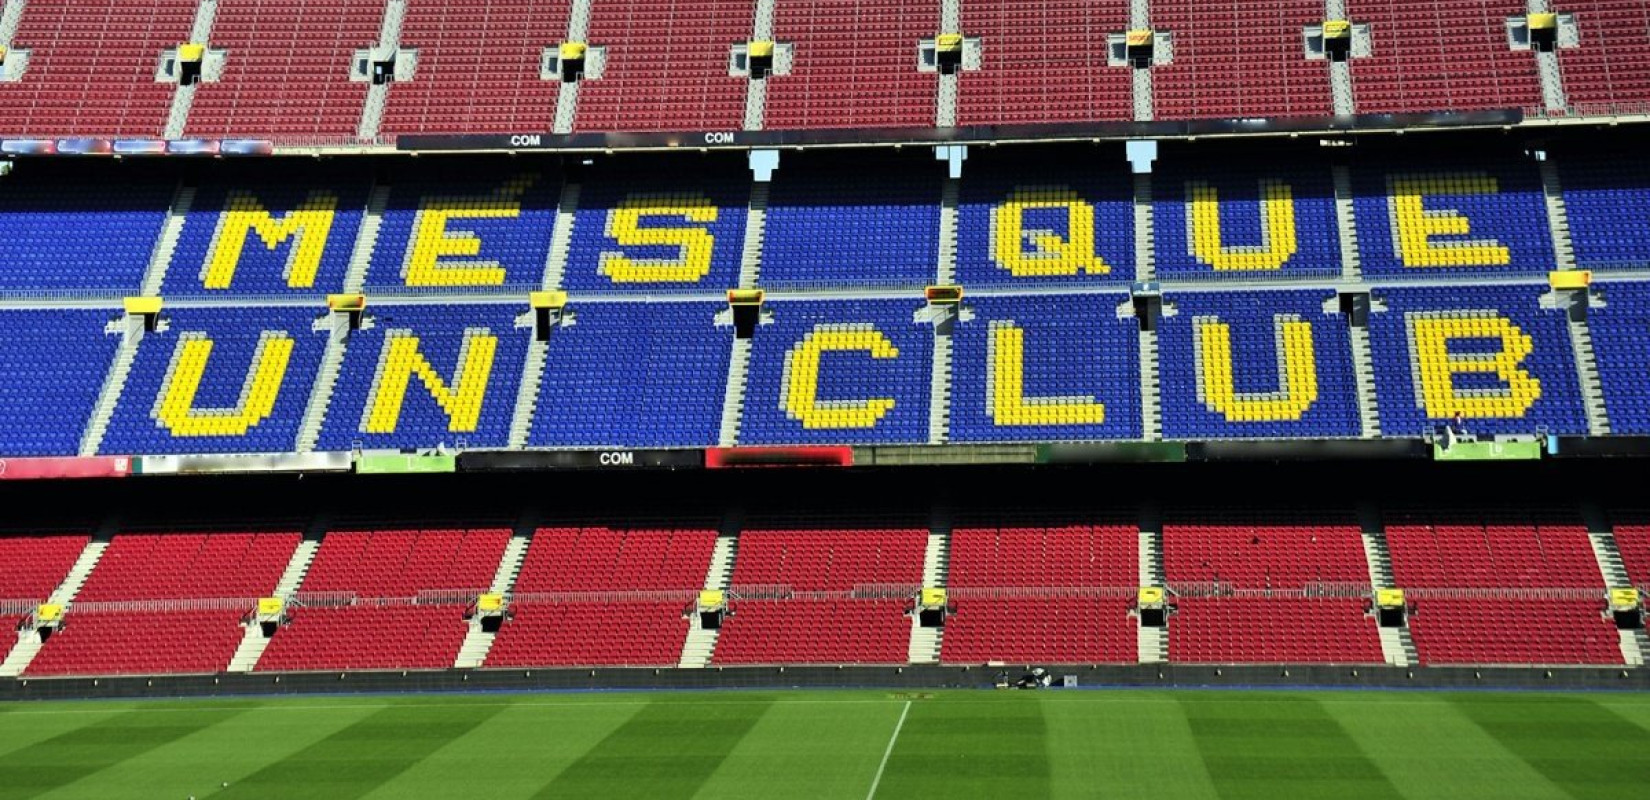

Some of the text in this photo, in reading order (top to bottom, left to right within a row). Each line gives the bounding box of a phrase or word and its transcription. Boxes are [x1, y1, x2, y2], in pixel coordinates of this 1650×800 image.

[510, 135, 541, 147] COM
[704, 131, 735, 144] COM
[199, 172, 1511, 288] MÉS QUE
[151, 308, 1542, 437] UN CLUB
[600, 451, 634, 466] COM
